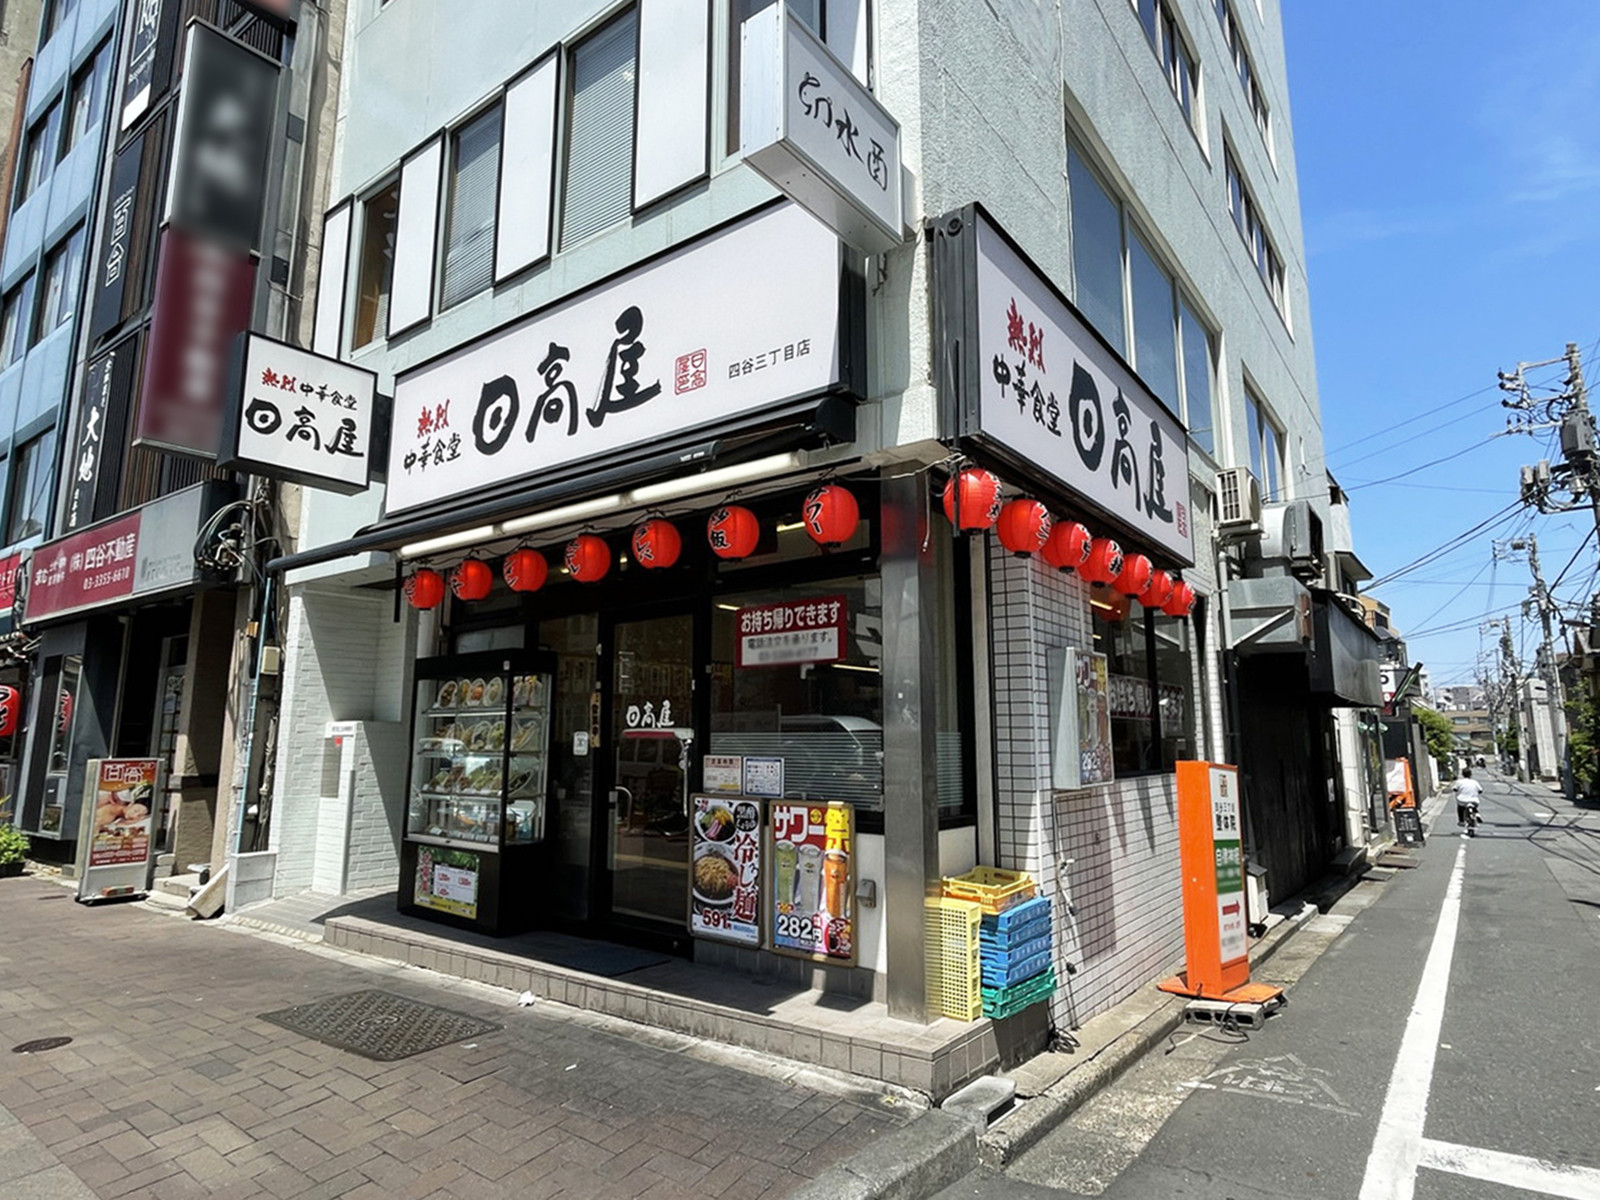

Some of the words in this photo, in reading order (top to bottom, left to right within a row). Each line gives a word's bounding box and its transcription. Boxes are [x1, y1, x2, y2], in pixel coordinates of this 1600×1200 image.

[728, 338, 811, 379] 四谷三丁目店
[1006, 296, 1047, 375] 熱烈
[472, 306, 662, 456] 日高屋
[993, 353, 1062, 437] 中華食堂
[245, 397, 364, 458] 日高屋
[417, 399, 451, 439] 熱烈
[1068, 358, 1174, 524] 日高屋
[402, 433, 462, 475] 中華食堂
[740, 600, 841, 634] お持ち帰りできます
[626, 699, 675, 728] 日高屋
[733, 834, 758, 921] 冷し麺
